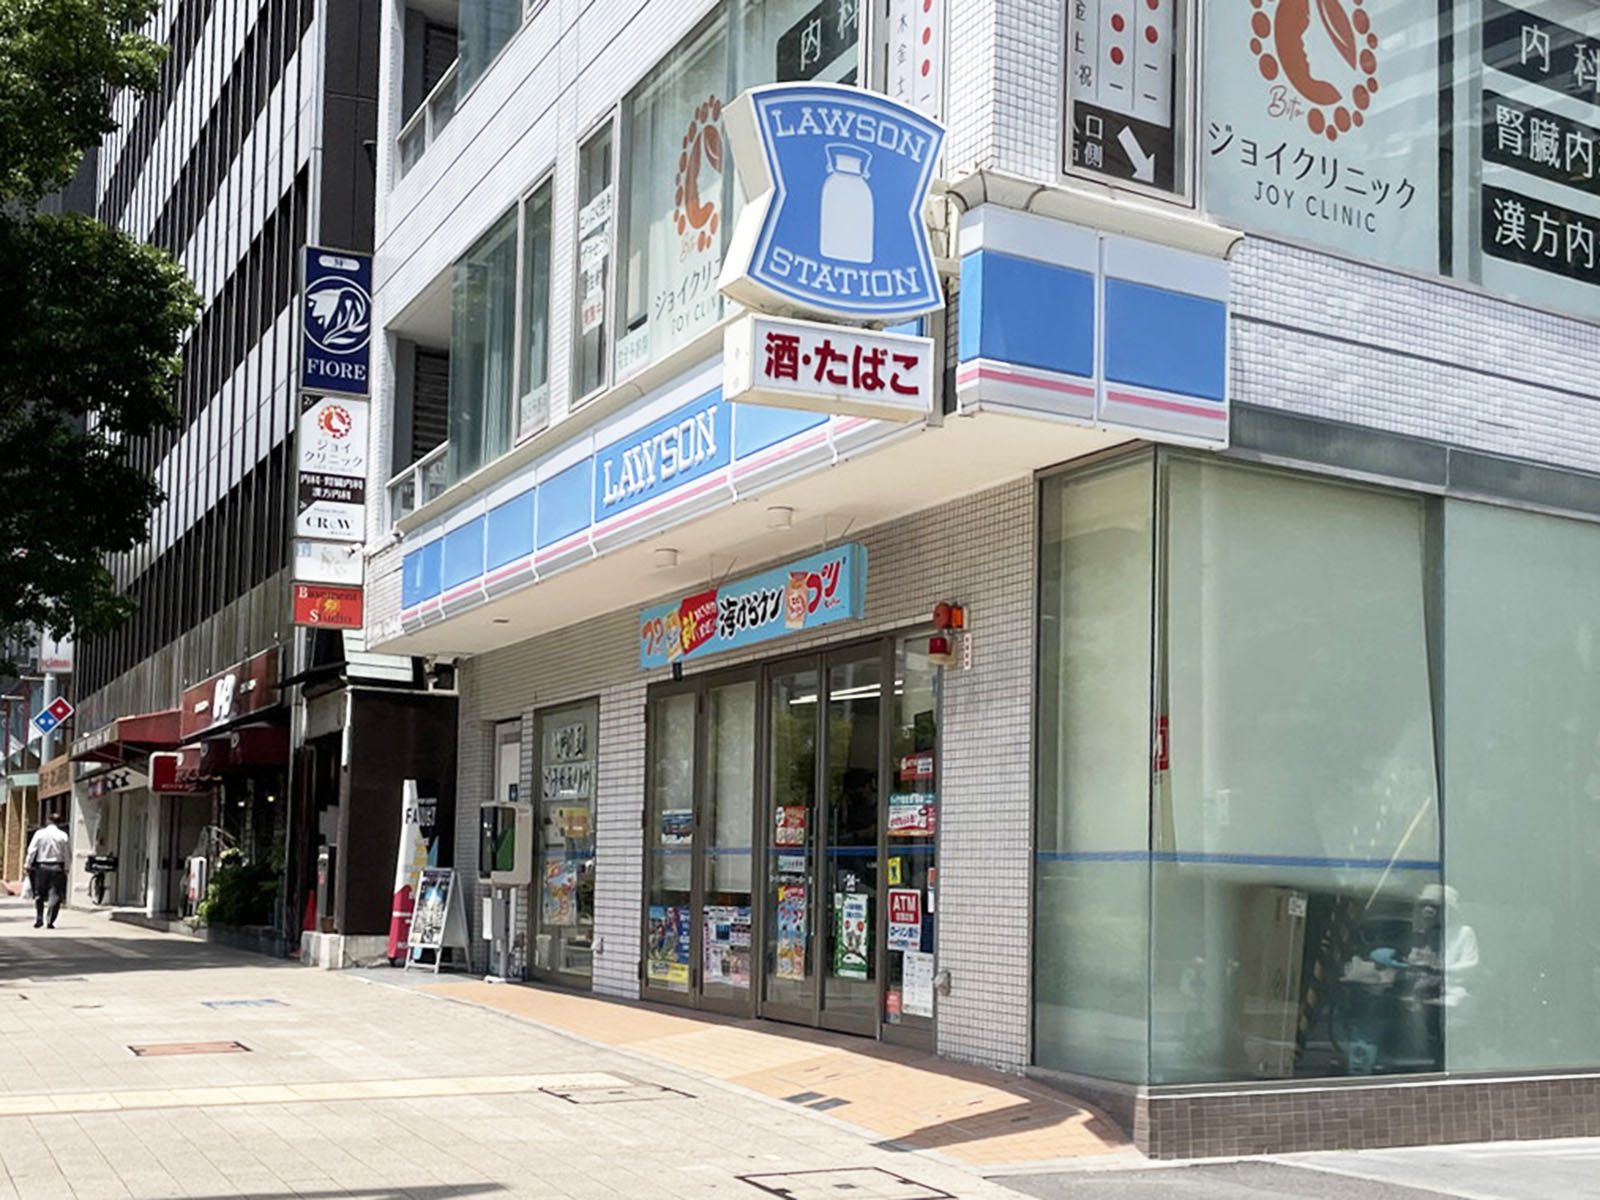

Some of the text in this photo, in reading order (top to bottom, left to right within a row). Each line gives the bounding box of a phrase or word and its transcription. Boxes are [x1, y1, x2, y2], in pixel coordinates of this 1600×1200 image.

[1520, 24, 1600, 94] 内科
[772, 107, 926, 163] LAWSON
[1208, 122, 1415, 209] ジョイクリニック
[1496, 104, 1600, 179] 腎臓内
[1254, 180, 1376, 233] JOY CLINIC
[1494, 198, 1600, 270] 漢方内
[769, 247, 921, 298] STATION
[307, 357, 367, 381] FIORE
[764, 331, 920, 397] 酒・たばこ
[317, 440, 351, 453] ジョイ
[602, 405, 719, 507] LAWSON
[892, 895, 917, 912] ATM
